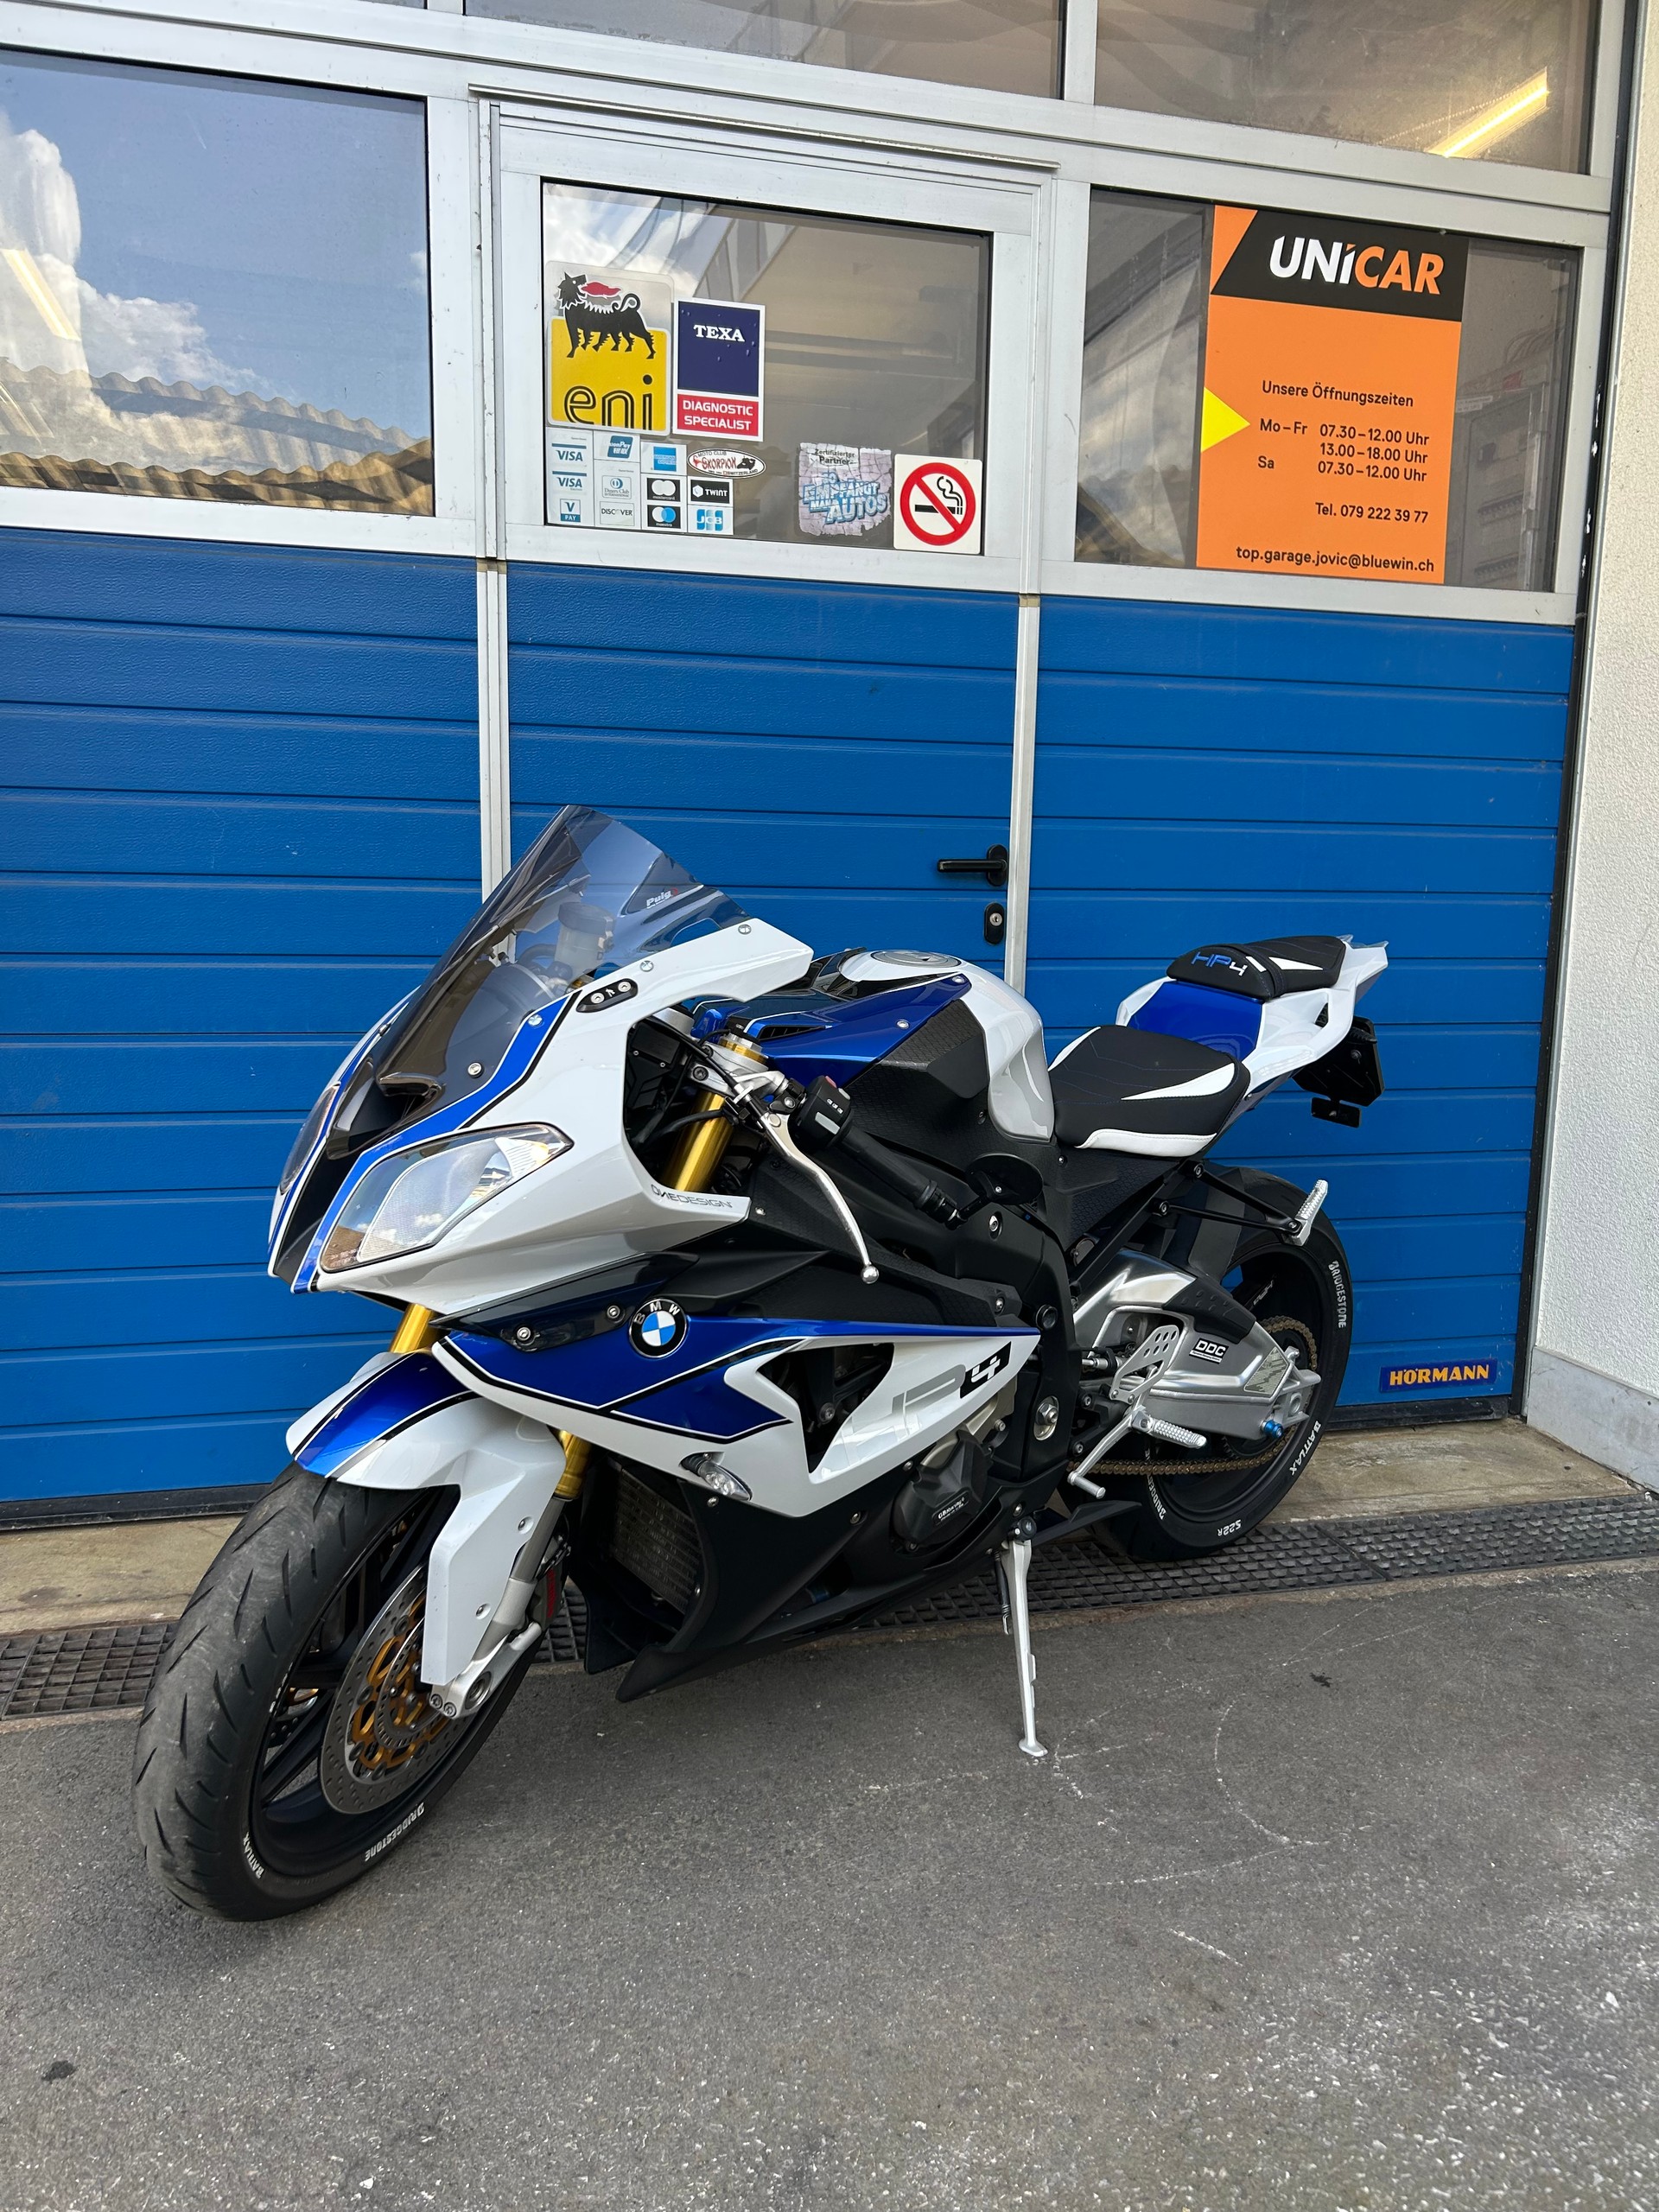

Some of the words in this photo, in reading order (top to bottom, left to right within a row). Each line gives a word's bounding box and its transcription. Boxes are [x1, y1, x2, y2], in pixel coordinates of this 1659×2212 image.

[693, 324, 746, 342] TEXA
[564, 374, 652, 430] eni
[1262, 380, 1308, 397] Unsere
[1313, 382, 1414, 407] Öffnungszeiten
[683, 399, 753, 416] DIAGNOSTIC
[683, 415, 752, 431] SPECIALIST
[1406, 433, 1429, 446] Uhr
[556, 449, 583, 461] VISA
[815, 448, 855, 458] Zertifizierter
[819, 455, 850, 465] Partner
[1404, 451, 1428, 464] Uhr
[1257, 455, 1274, 469] Sa
[1403, 469, 1427, 482] Uhr
[556, 476, 583, 487] VISA
[704, 488, 728, 497] TWINT
[564, 501, 575, 512] V
[825, 493, 888, 524] AUTOS
[1315, 502, 1337, 516] Tel.
[1340, 505, 1363, 518] 079
[1368, 506, 1391, 521] 222
[1395, 509, 1410, 522] 39
[1414, 511, 1428, 524] 77
[1236, 545, 1434, 572] top.garage.jovic@bluewin.ch
[1192, 951, 1249, 976] HP4
[1328, 1260, 1347, 1329] BRIDGESTONE
[633, 1300, 681, 1325] BMW
[1195, 1339, 1226, 1357] DDC
[1389, 1363, 1490, 1386] HÖRMANN
[1289, 1421, 1322, 1475] BATTLAX
[365, 1802, 425, 1862] BRIDGESTONE
